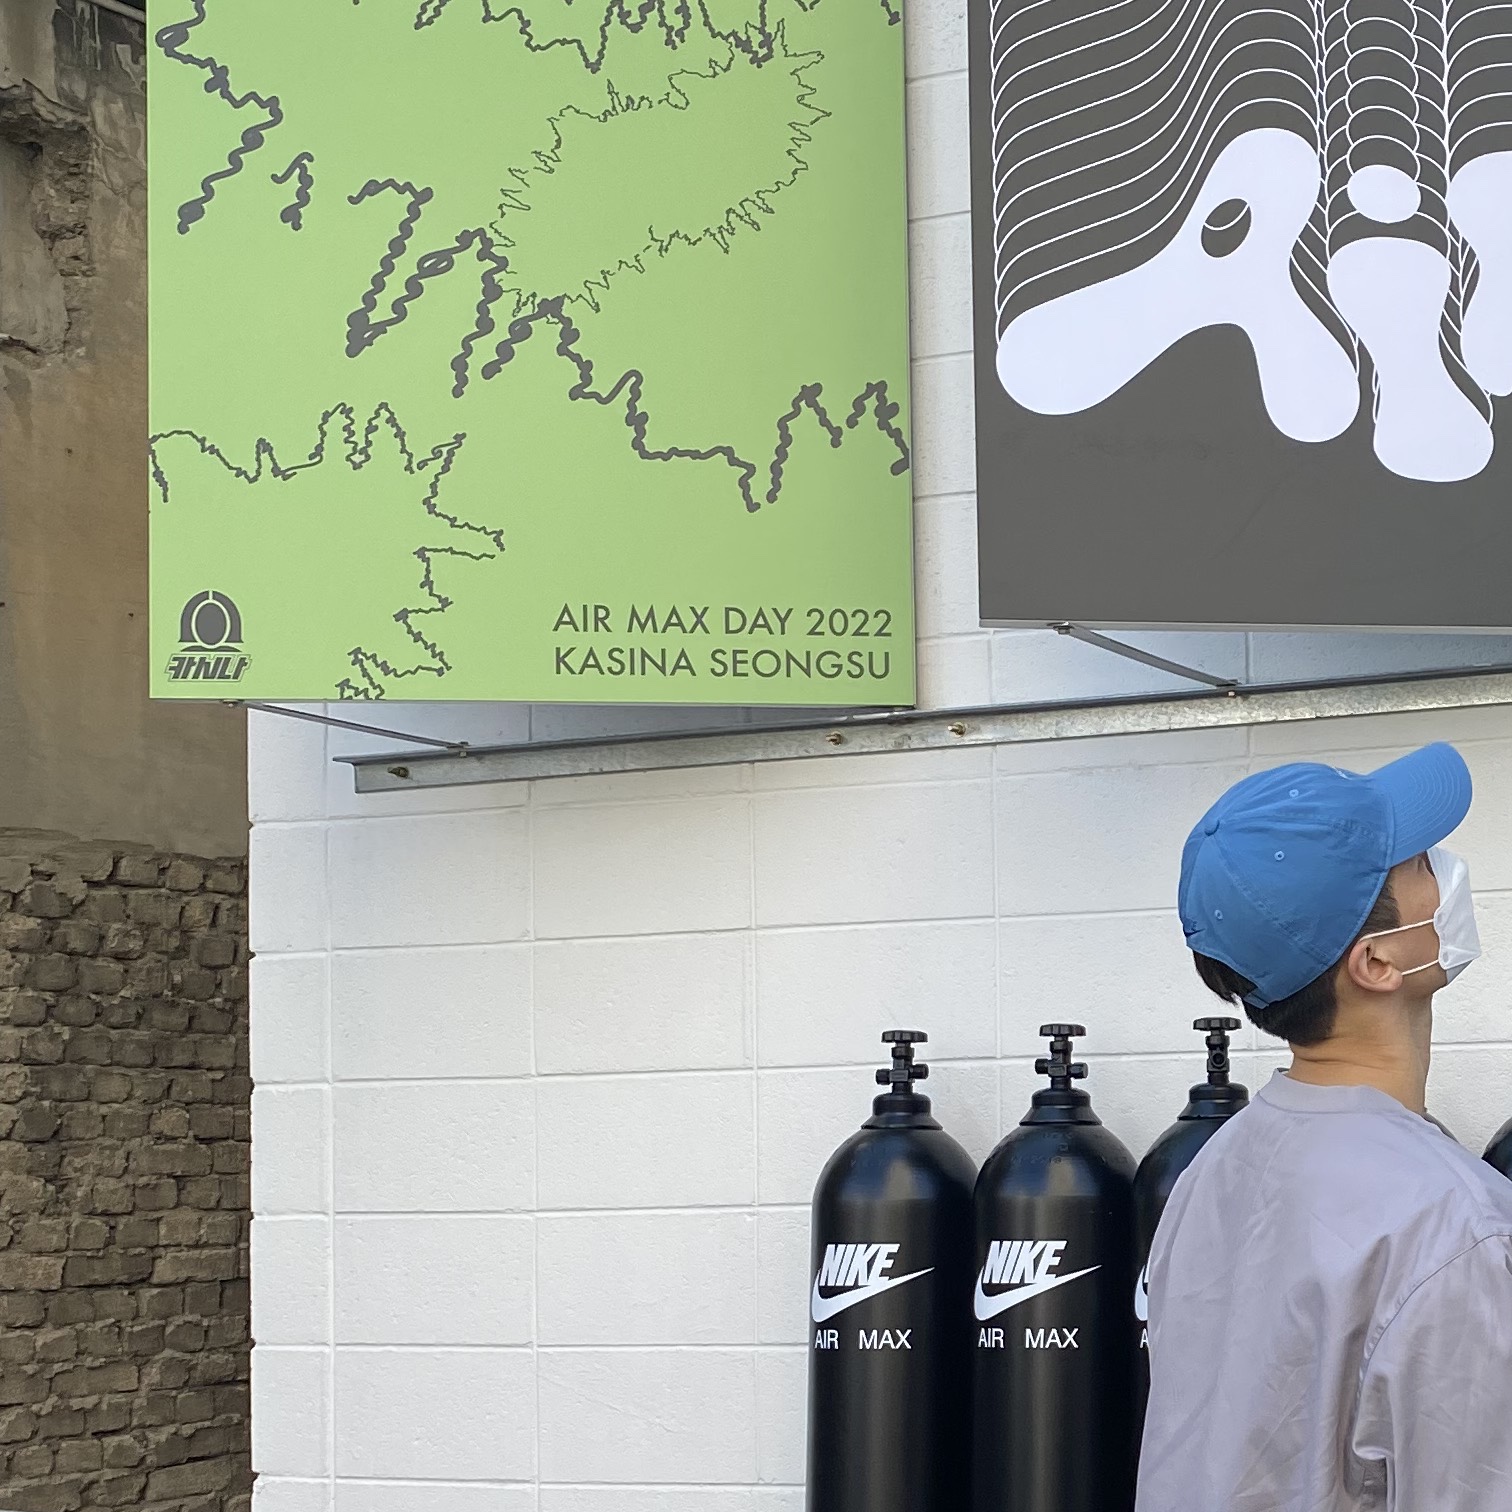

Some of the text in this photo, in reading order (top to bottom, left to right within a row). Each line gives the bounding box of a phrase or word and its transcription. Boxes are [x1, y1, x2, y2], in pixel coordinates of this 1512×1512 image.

[552, 603, 893, 637] AIR MAX DAY 2022
[555, 646, 890, 680] KASINA SEONGSU
[819, 1243, 900, 1286] NIKE
[982, 1240, 1068, 1284] NIKE
[814, 1328, 912, 1350] AIR MAX
[977, 1327, 1079, 1349] AIR MAX
